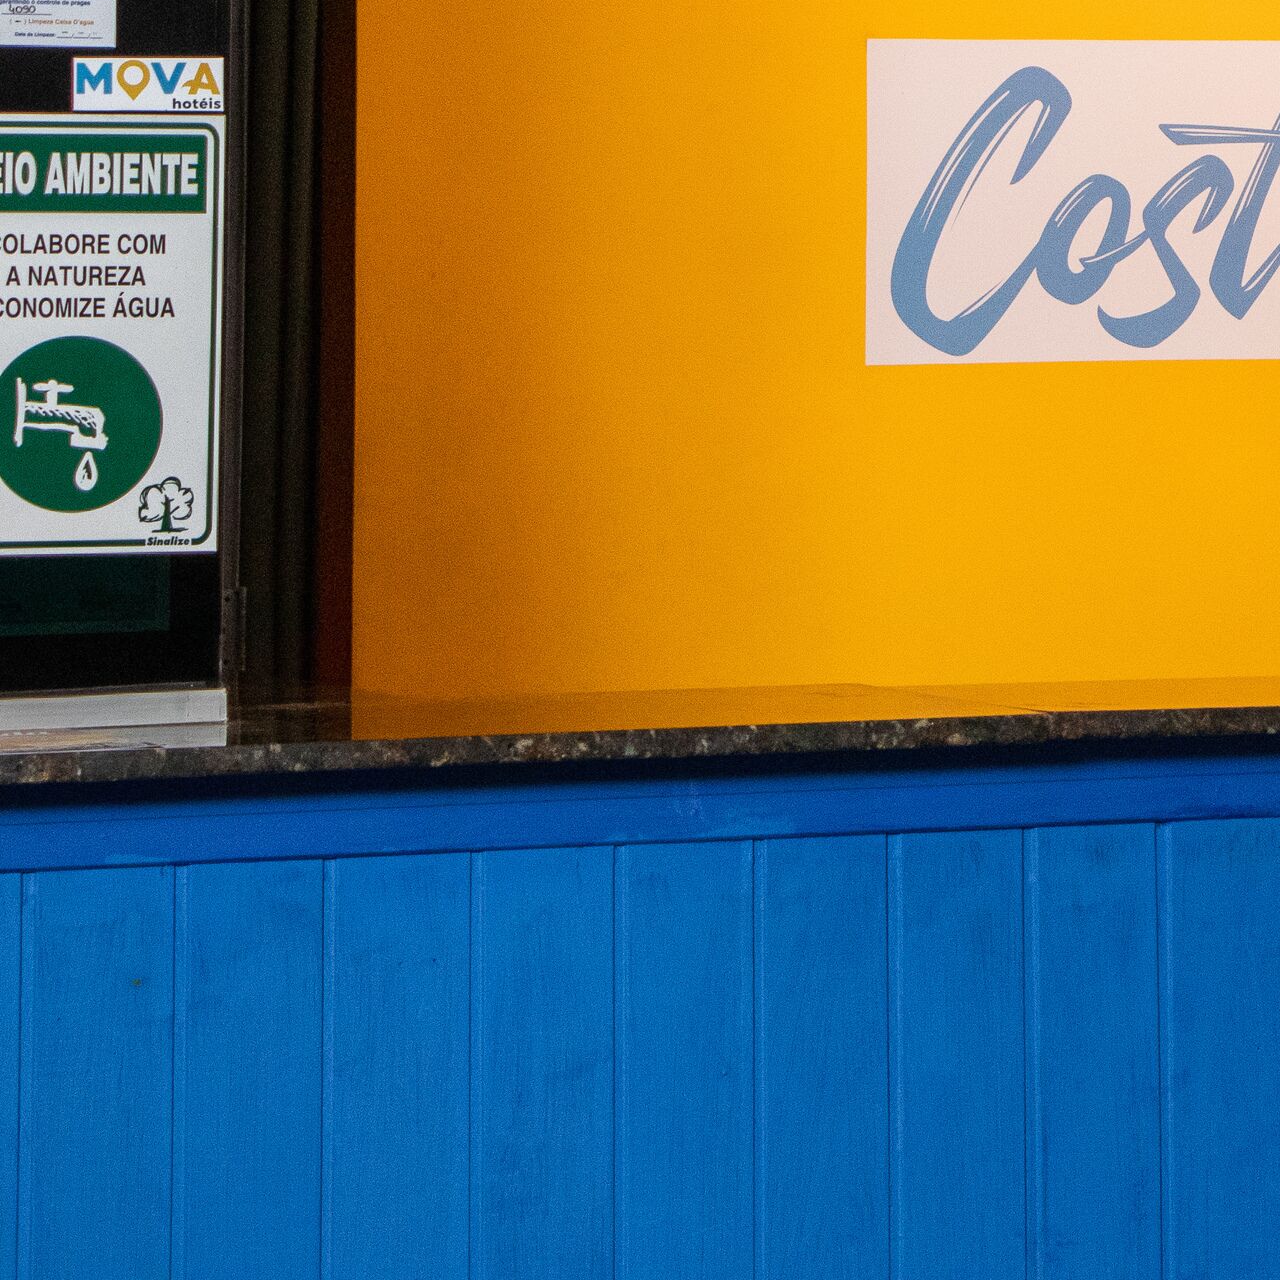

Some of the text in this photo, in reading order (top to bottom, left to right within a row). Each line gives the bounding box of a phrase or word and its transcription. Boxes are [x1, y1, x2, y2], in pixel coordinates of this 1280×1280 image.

[76, 60, 220, 101] MOVA
[172, 98, 222, 109] hotéis
[45, 152, 199, 195] AMBIENTE
[0, 234, 166, 254] OLABORE COM
[6, 266, 146, 286] A NATUREZA
[113, 291, 175, 318] ÁGUA
[147, 537, 190, 545] Sinalize
